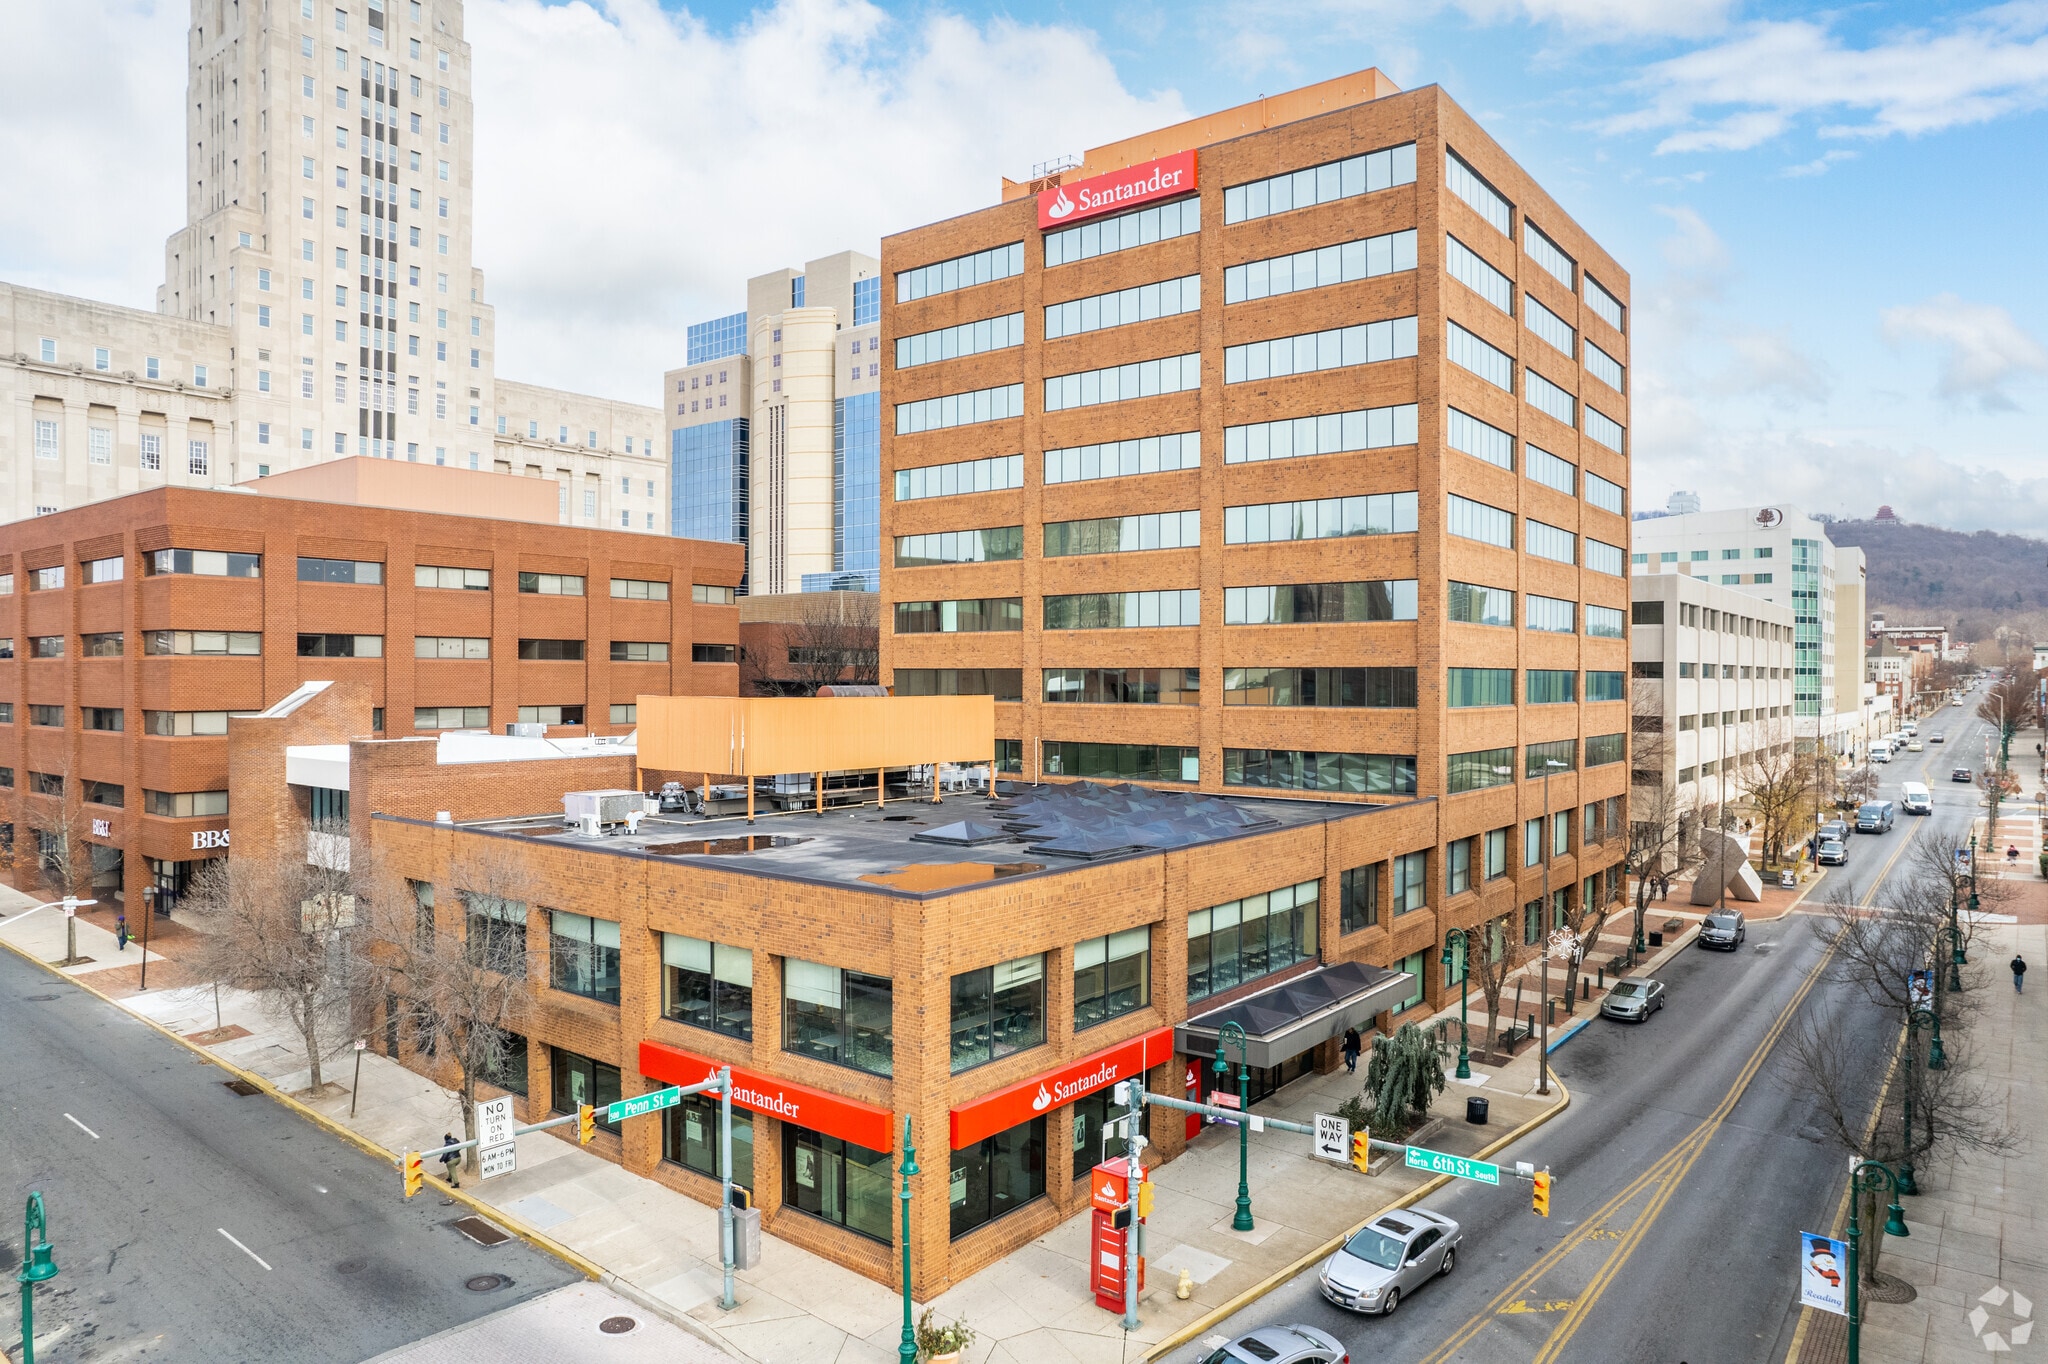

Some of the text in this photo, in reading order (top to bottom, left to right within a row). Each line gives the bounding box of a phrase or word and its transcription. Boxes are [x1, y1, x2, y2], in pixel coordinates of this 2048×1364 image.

[1079, 166, 1183, 211] Santander
[1054, 1062, 1118, 1103] Santander
[486, 1102, 504, 1116] NO
[625, 1100, 649, 1116] Penn
[652, 1094, 664, 1108] St
[485, 1114, 506, 1125] TURN
[1321, 1118, 1342, 1132] ONE
[490, 1124, 502, 1134] ON
[489, 1133, 505, 1143] RED
[1320, 1130, 1342, 1143] WAY
[505, 1147, 514, 1157] PM
[484, 1164, 495, 1174] MON
[497, 1161, 504, 1170] TO
[1408, 1155, 1496, 1182] North 6th St South
[1803, 1288, 1843, 1308] Reading
